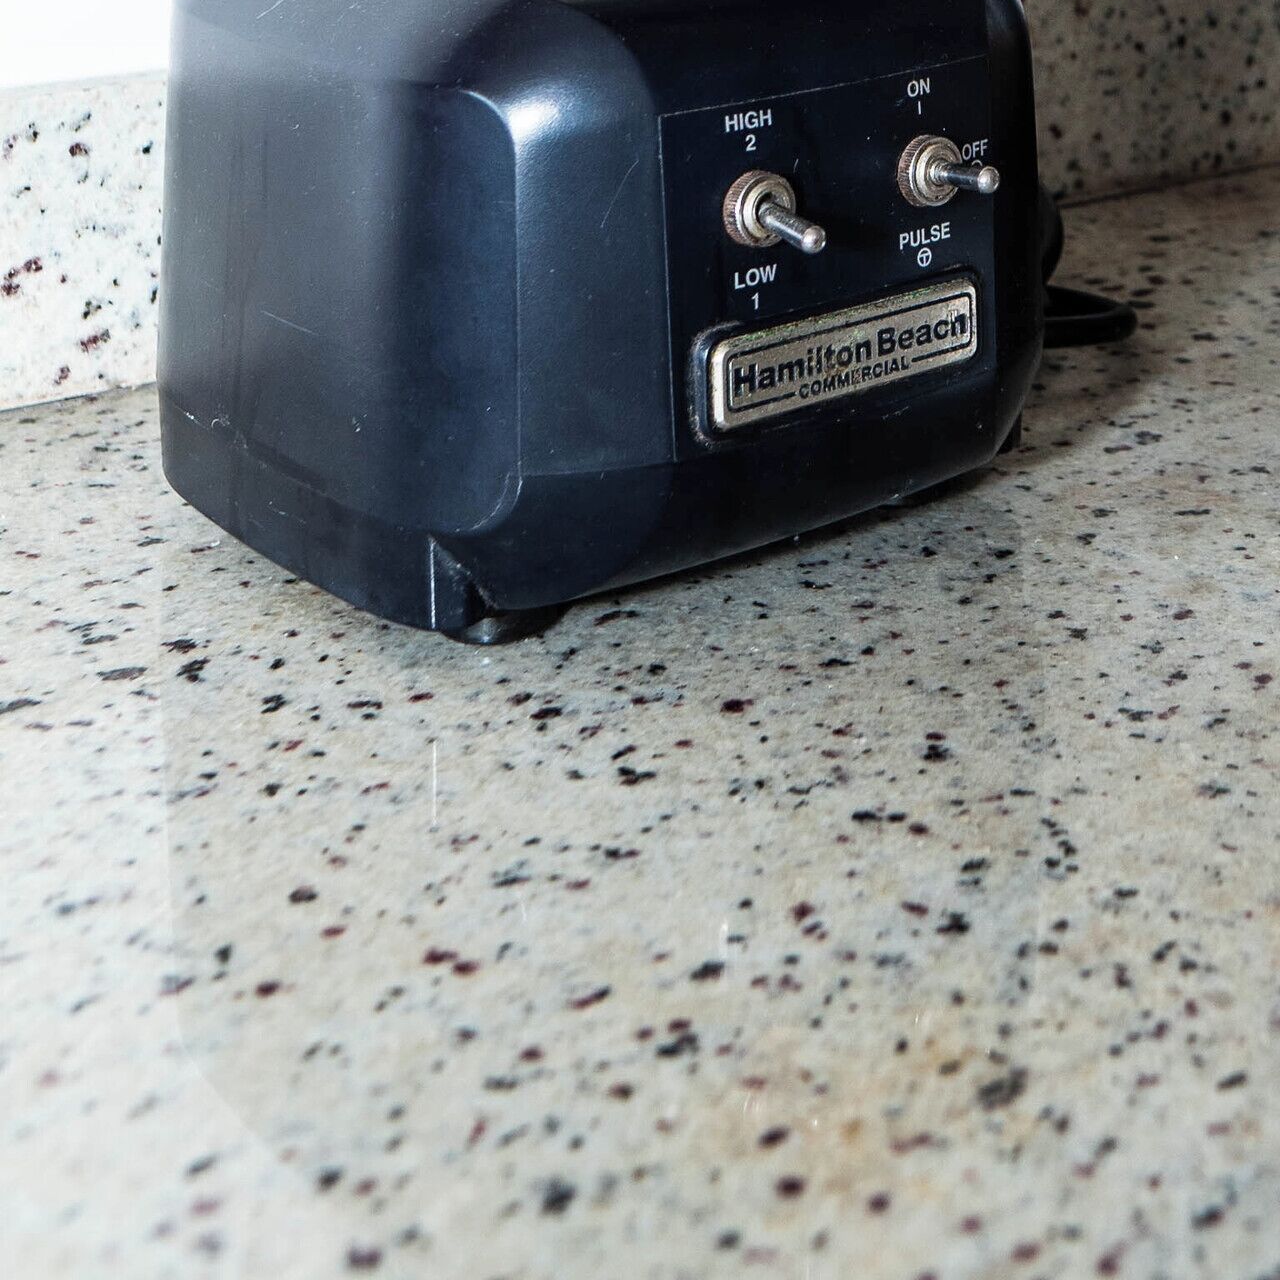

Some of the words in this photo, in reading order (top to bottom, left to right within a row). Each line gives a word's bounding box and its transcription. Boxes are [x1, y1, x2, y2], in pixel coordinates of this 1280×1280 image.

[907, 77, 931, 97] ON
[725, 108, 772, 133] HIGH
[745, 134, 757, 151] 2
[962, 138, 989, 160] OFF
[899, 221, 951, 250] PULSE
[734, 263, 777, 290] LOW
[751, 292, 759, 310] 1
[733, 338, 873, 398] Hamilton
[876, 310, 969, 357] Beach
[798, 356, 910, 400] COMMERCIAL
